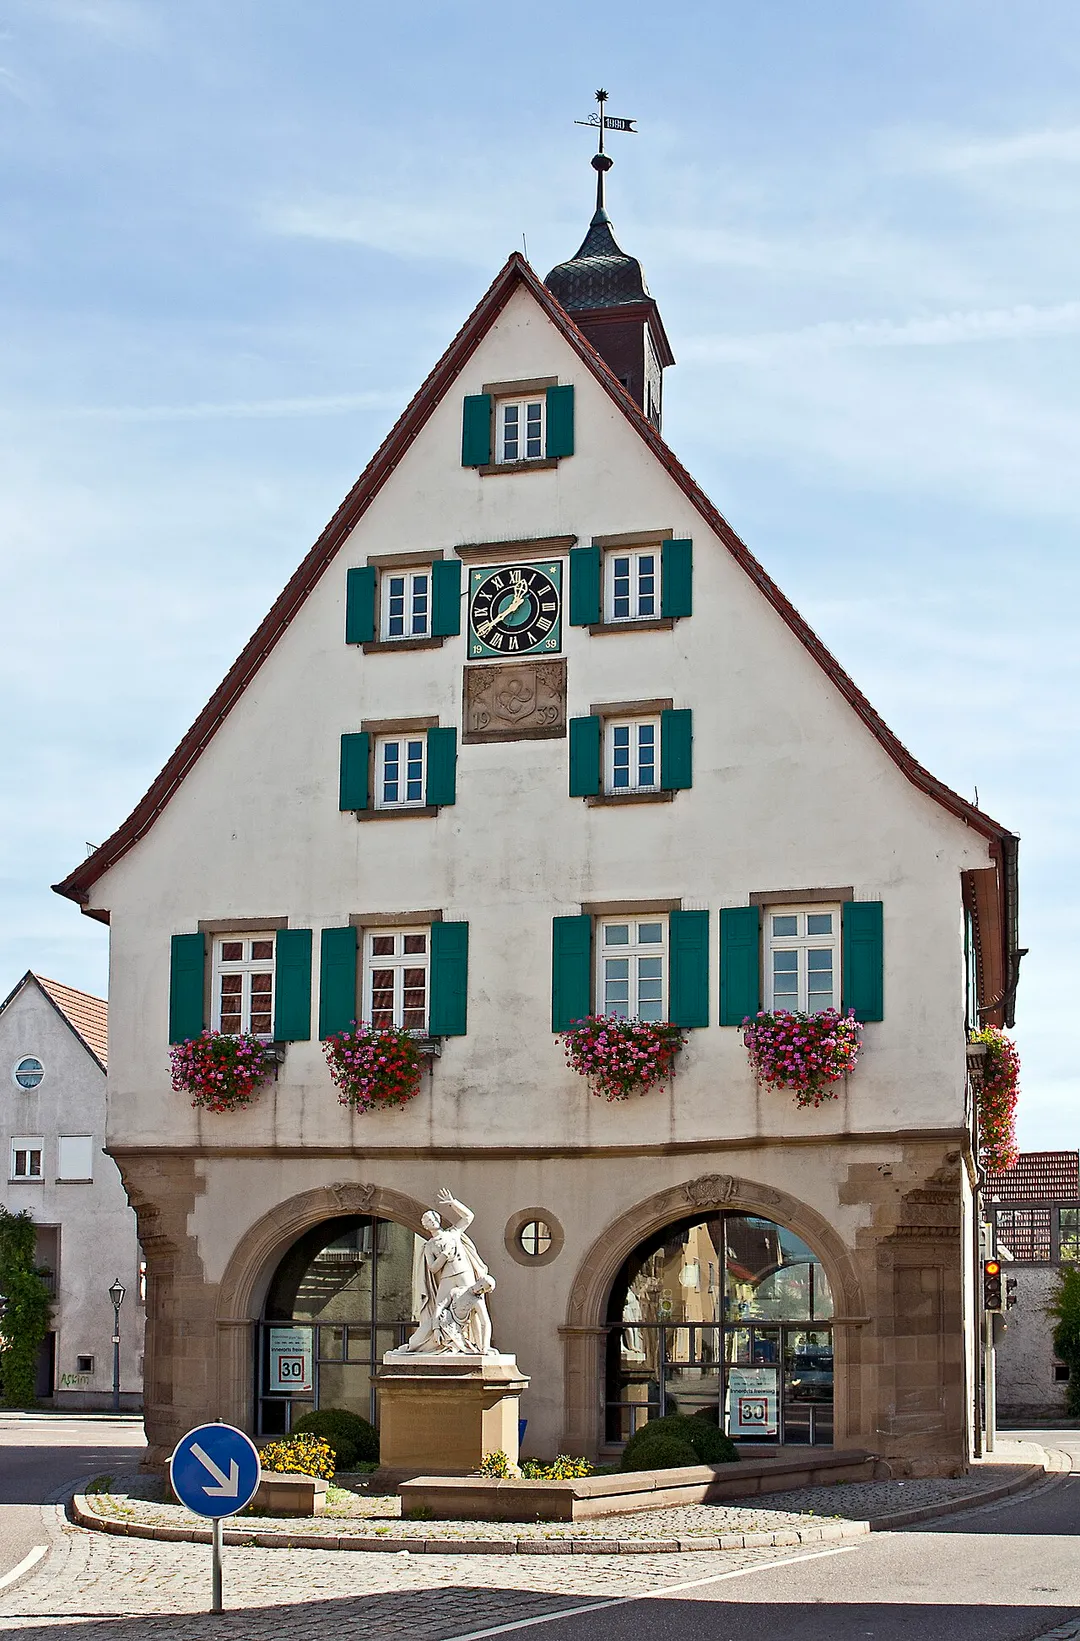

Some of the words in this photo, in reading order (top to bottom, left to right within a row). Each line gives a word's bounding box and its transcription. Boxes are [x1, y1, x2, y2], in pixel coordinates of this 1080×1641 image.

[491, 575, 504, 591] XI
[528, 573, 537, 586] I
[479, 590, 493, 601] X
[538, 585, 551, 596] II
[474, 607, 489, 617] IX
[541, 602, 556, 612] III
[489, 632, 504, 649] VII
[508, 636, 519, 650] VI
[527, 631, 538, 645] V
[472, 645, 482, 654] 19
[545, 639, 557, 648] 39
[473, 712, 491, 730] 19
[537, 705, 559, 725] 39
[282, 1363, 301, 1377] 30
[743, 1404, 764, 1420] 30
